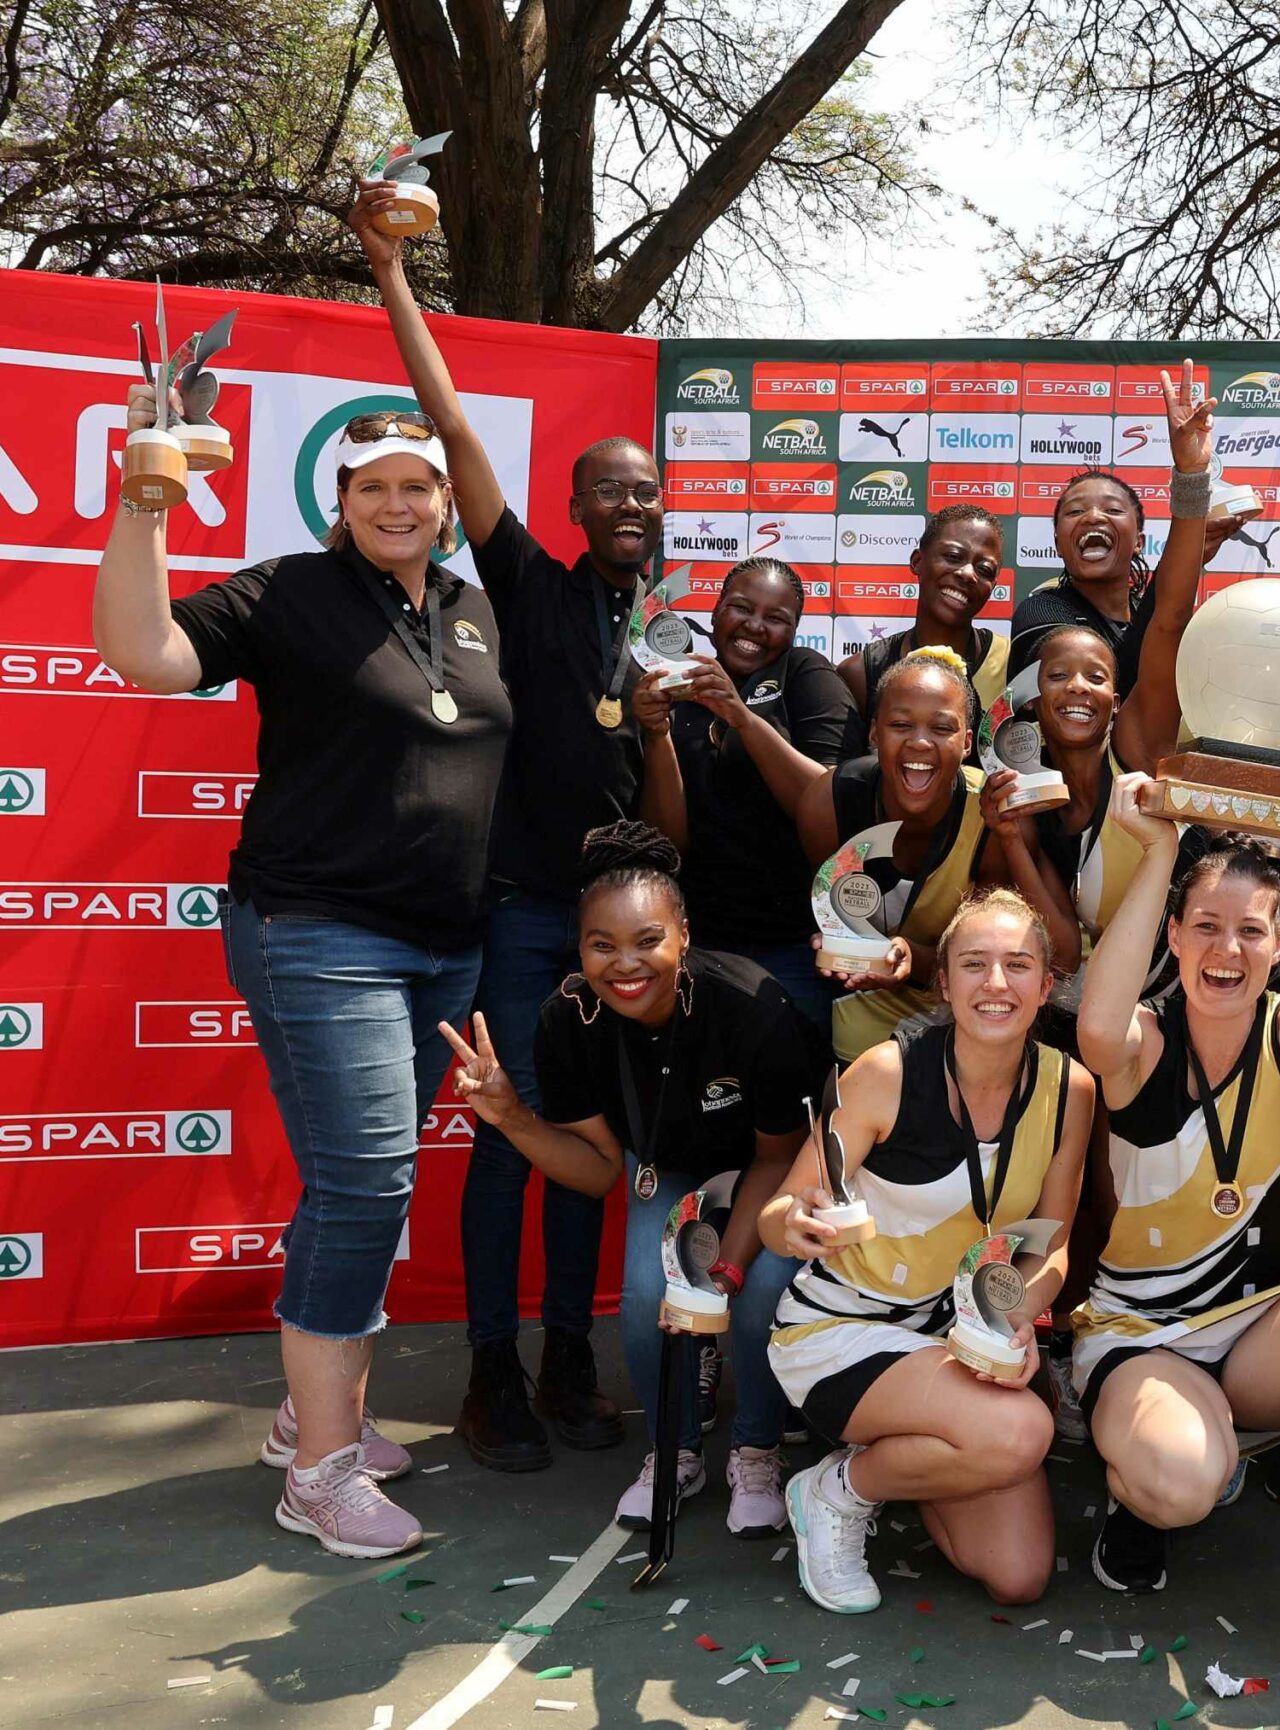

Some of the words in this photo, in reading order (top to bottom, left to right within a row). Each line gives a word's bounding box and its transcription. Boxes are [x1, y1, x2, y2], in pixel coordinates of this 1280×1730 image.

[676, 385, 740, 399] NETBALL
[771, 382, 816, 392] SPAR
[859, 382, 906, 392] SPAR
[950, 382, 997, 392] SPAR
[1042, 383, 1089, 394] SPAR
[762, 435, 827, 449] NETBALL
[936, 428, 1014, 448] Telkom
[1030, 440, 1102, 455] HOLLYWOOD
[683, 481, 727, 491] SPAR
[768, 482, 814, 492] SPAR
[946, 484, 993, 494] SPAR
[1038, 486, 1061, 496] SP
[849, 487, 915, 501] NETBALL
[1132, 488, 1171, 497] SPA
[1254, 489, 1276, 498] AR
[673, 536, 738, 551] HOLLYWOOD
[859, 533, 921, 548] Discovery
[853, 585, 900, 596] SPAR
[1, 654, 139, 688] SPA
[191, 782, 258, 811] SP
[850, 881, 870, 890] 2023
[0, 890, 163, 920] SPAR
[844, 899, 871, 907] NETBALL
[189, 1010, 255, 1038] SP
[0, 1119, 161, 1153] SPAR
[997, 1270, 1016, 1284] 2023
